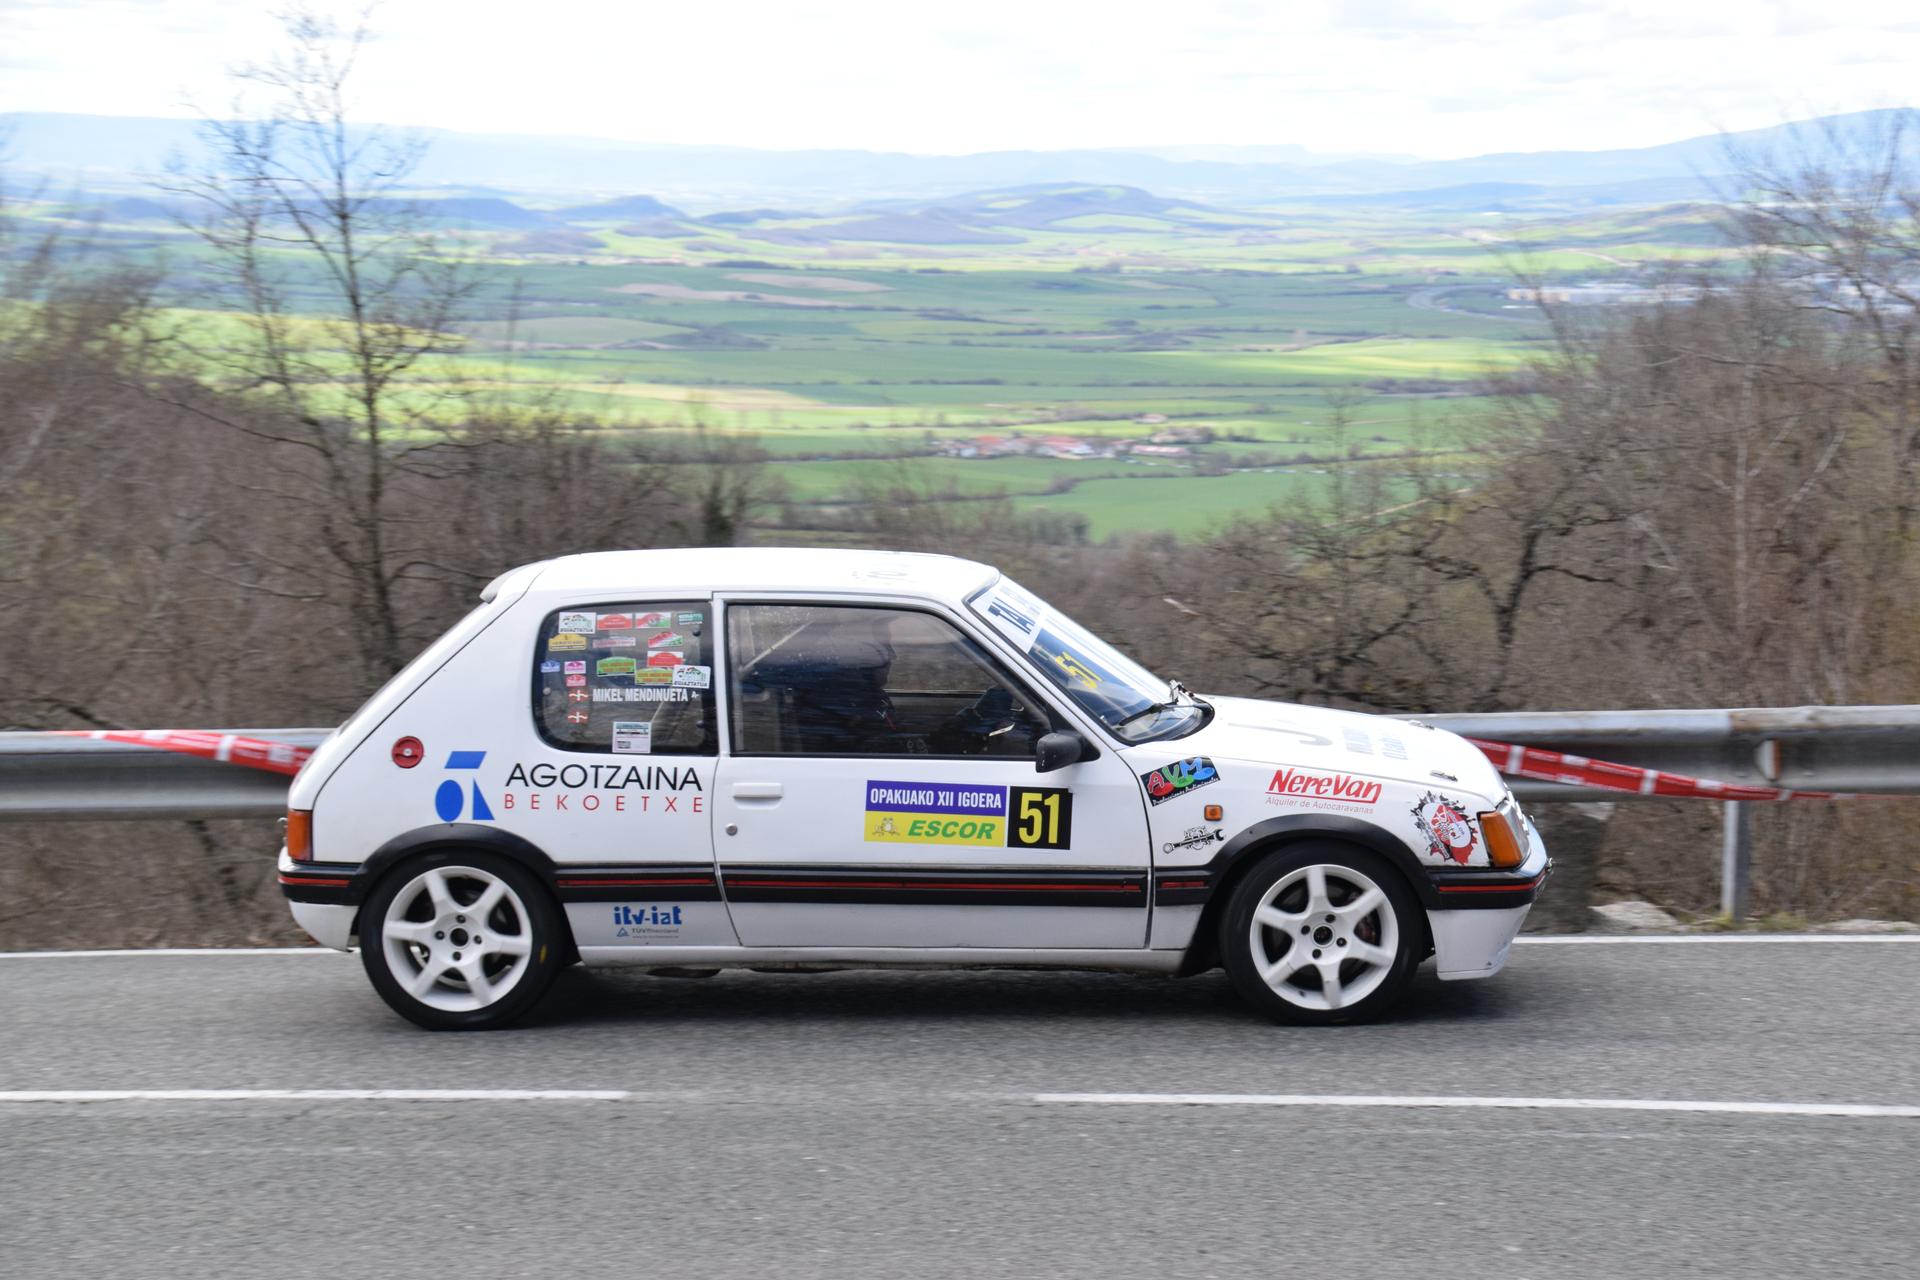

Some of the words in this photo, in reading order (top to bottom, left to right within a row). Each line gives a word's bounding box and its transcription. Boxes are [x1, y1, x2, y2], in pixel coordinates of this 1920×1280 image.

[592, 688, 623, 702] MIKEL
[625, 688, 689, 702] MENDINUETA
[504, 763, 703, 792] AGOTZAINA
[1147, 757, 1203, 793] AVM
[1268, 768, 1383, 802] NereVan
[504, 794, 703, 813] BEKOETXE
[870, 788, 934, 806] OPAKUAKO
[937, 791, 954, 807] XII
[958, 792, 1002, 809] IGOERA
[1265, 797, 1298, 807] Alquiler
[1299, 800, 1311, 808] de
[1312, 801, 1374, 814] Autocaravanas
[1018, 792, 1060, 844] 51
[907, 820, 996, 839] ESCOR
[614, 906, 682, 925] itv-iat
